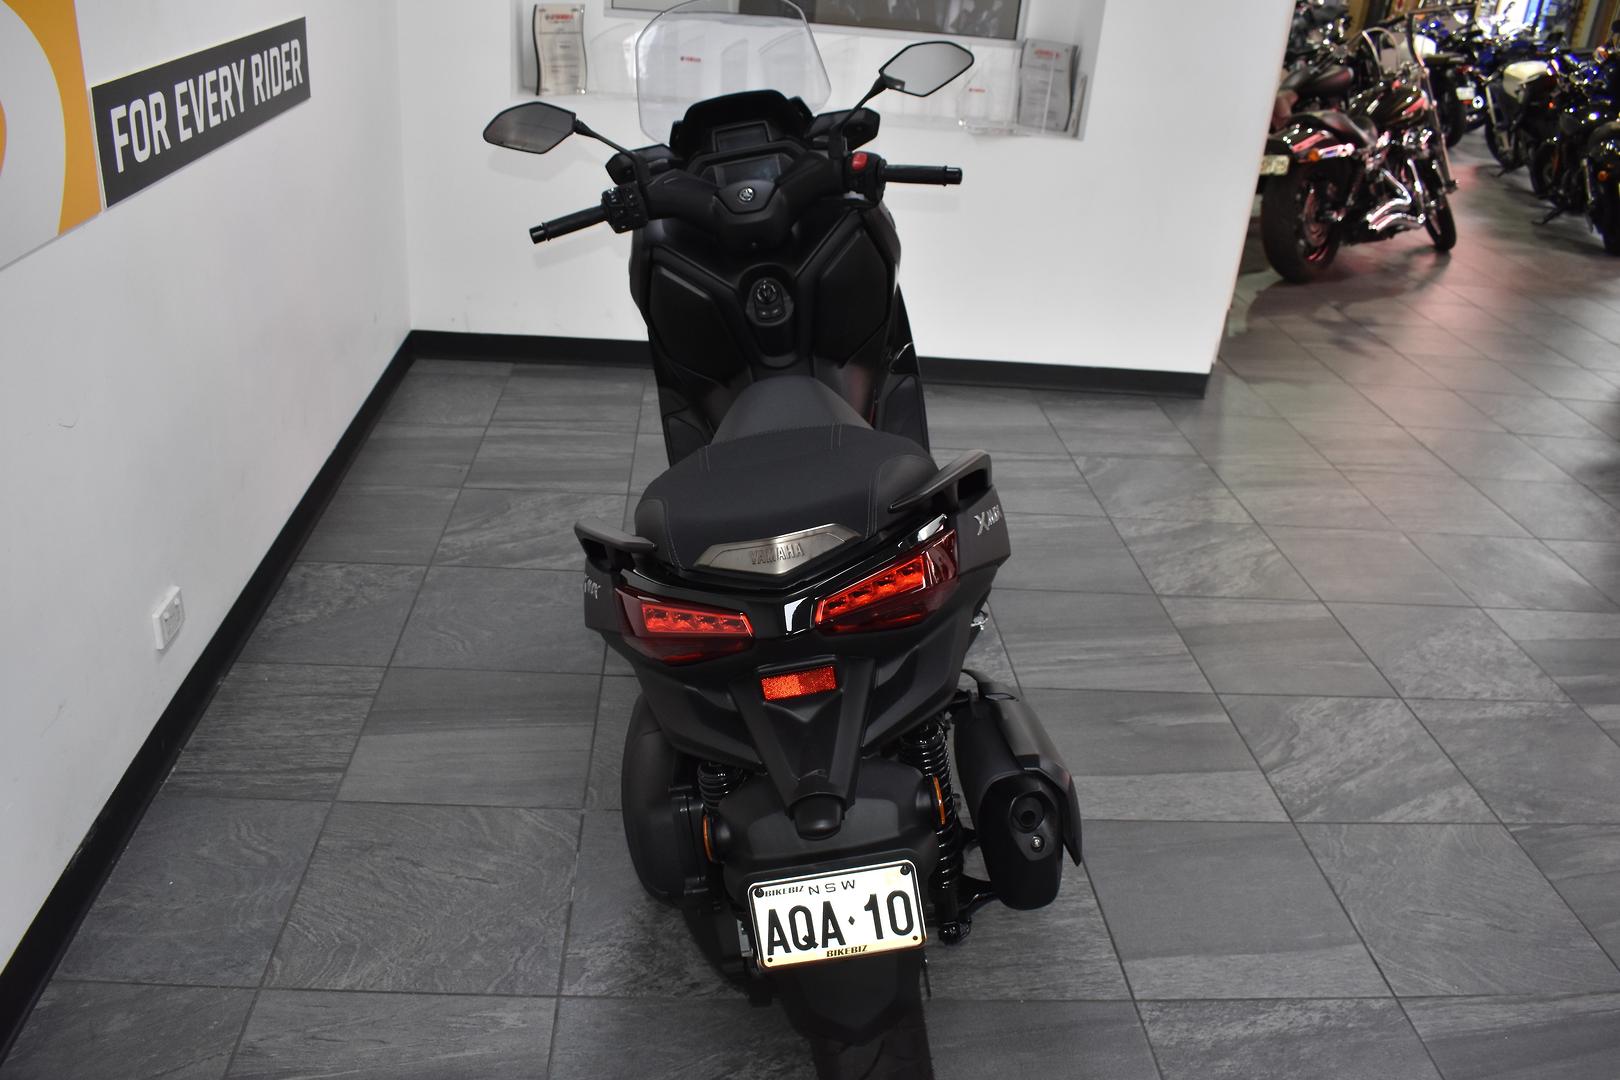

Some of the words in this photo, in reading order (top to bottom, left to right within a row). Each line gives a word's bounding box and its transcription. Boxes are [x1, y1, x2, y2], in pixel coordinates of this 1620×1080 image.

[110, 90, 171, 173] FOR
[174, 59, 245, 143] EVERY
[251, 38, 303, 106] RIDER
[750, 543, 805, 565] YAMAHA
[808, 879, 855, 896] NSW
[826, 944, 868, 958] BIKEBIZ
